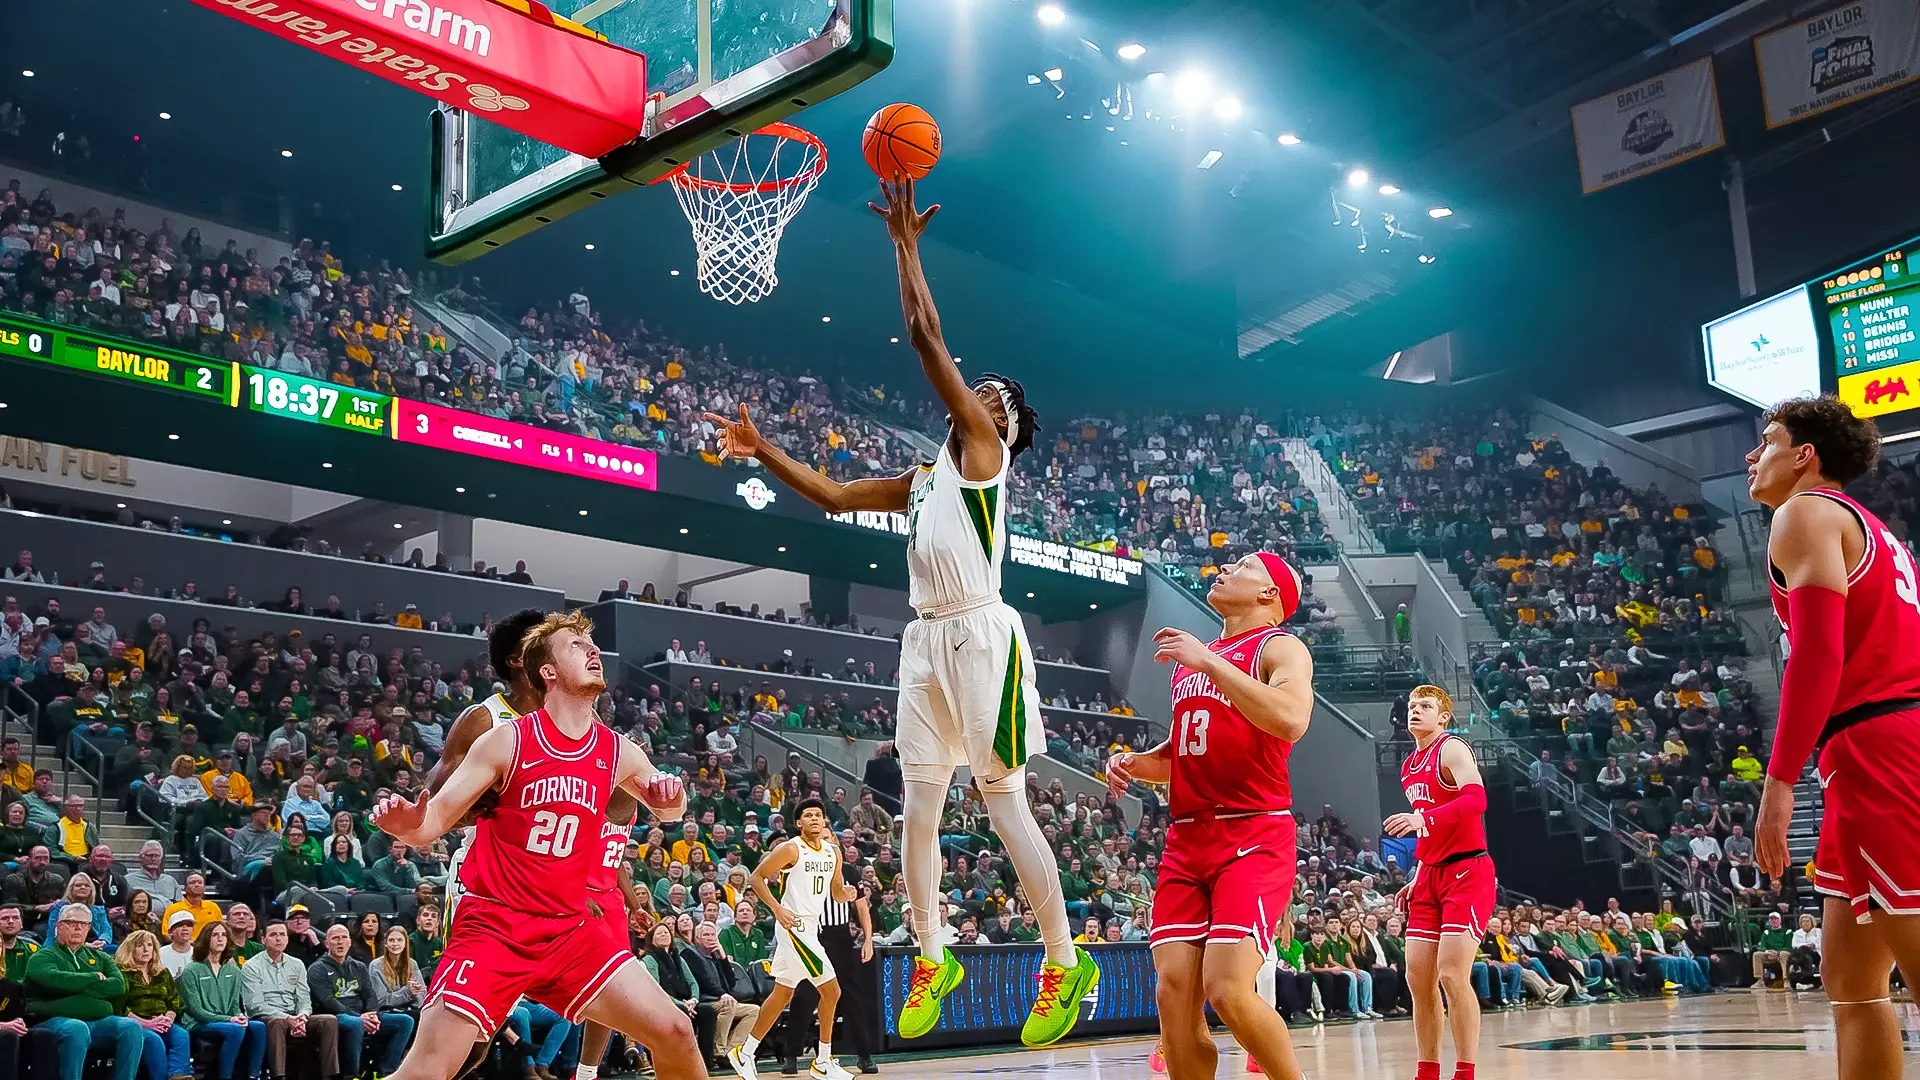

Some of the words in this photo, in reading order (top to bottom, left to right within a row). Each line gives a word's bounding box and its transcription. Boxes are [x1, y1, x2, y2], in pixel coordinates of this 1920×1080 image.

[1807, 6, 1862, 37] BAYLOR
[1827, 39, 1870, 61] FINAL
[1813, 50, 1871, 86] FOUR
[1616, 79, 1665, 109] BAYLOR
[1809, 88, 1852, 109] NATIONAL
[1854, 69, 1908, 96] CHAMPIONS
[1885, 250, 1902, 262] FLS
[1892, 263, 1899, 273] 0
[1823, 280, 1836, 289] TO
[1827, 294, 1840, 304] ON
[1841, 290, 1858, 301] THE
[1859, 283, 1886, 297] FLOOR
[1841, 307, 1849, 317] 2
[1859, 296, 1894, 313] NUNN
[1860, 305, 1910, 325] WALTER
[28, 333, 42, 353] 0
[1842, 331, 1856, 343] 10
[1863, 319, 1907, 339] DENNIS
[1844, 344, 1857, 355] 11
[1864, 331, 1916, 351] BRIDGES
[97, 347, 170, 381] BAYLOR
[196, 367, 212, 389] 2
[1845, 356, 1858, 368] 21
[1866, 347, 1899, 363] MISSI
[249, 373, 340, 419] 18:37
[352, 396, 379, 414] 1ST
[344, 412, 384, 430] HALF
[416, 413, 429, 434] 3
[452, 425, 512, 449] CORNELL
[541, 443, 560, 457] FLS
[566, 447, 574, 462] 1
[582, 452, 596, 465] TO
[60, 448, 137, 488] FUEL
[1070, 560, 1099, 579] FIRST
[1118, 558, 1142, 576] FIRST
[1880, 527, 1919, 613] 3
[1179, 709, 1210, 756] 13
[520, 775, 598, 816] CORNELL
[526, 810, 580, 858] 20
[602, 840, 625, 869] 23
[804, 861, 834, 873] BAYLOR
[812, 875, 825, 896] 10
[455, 959, 476, 985] C
